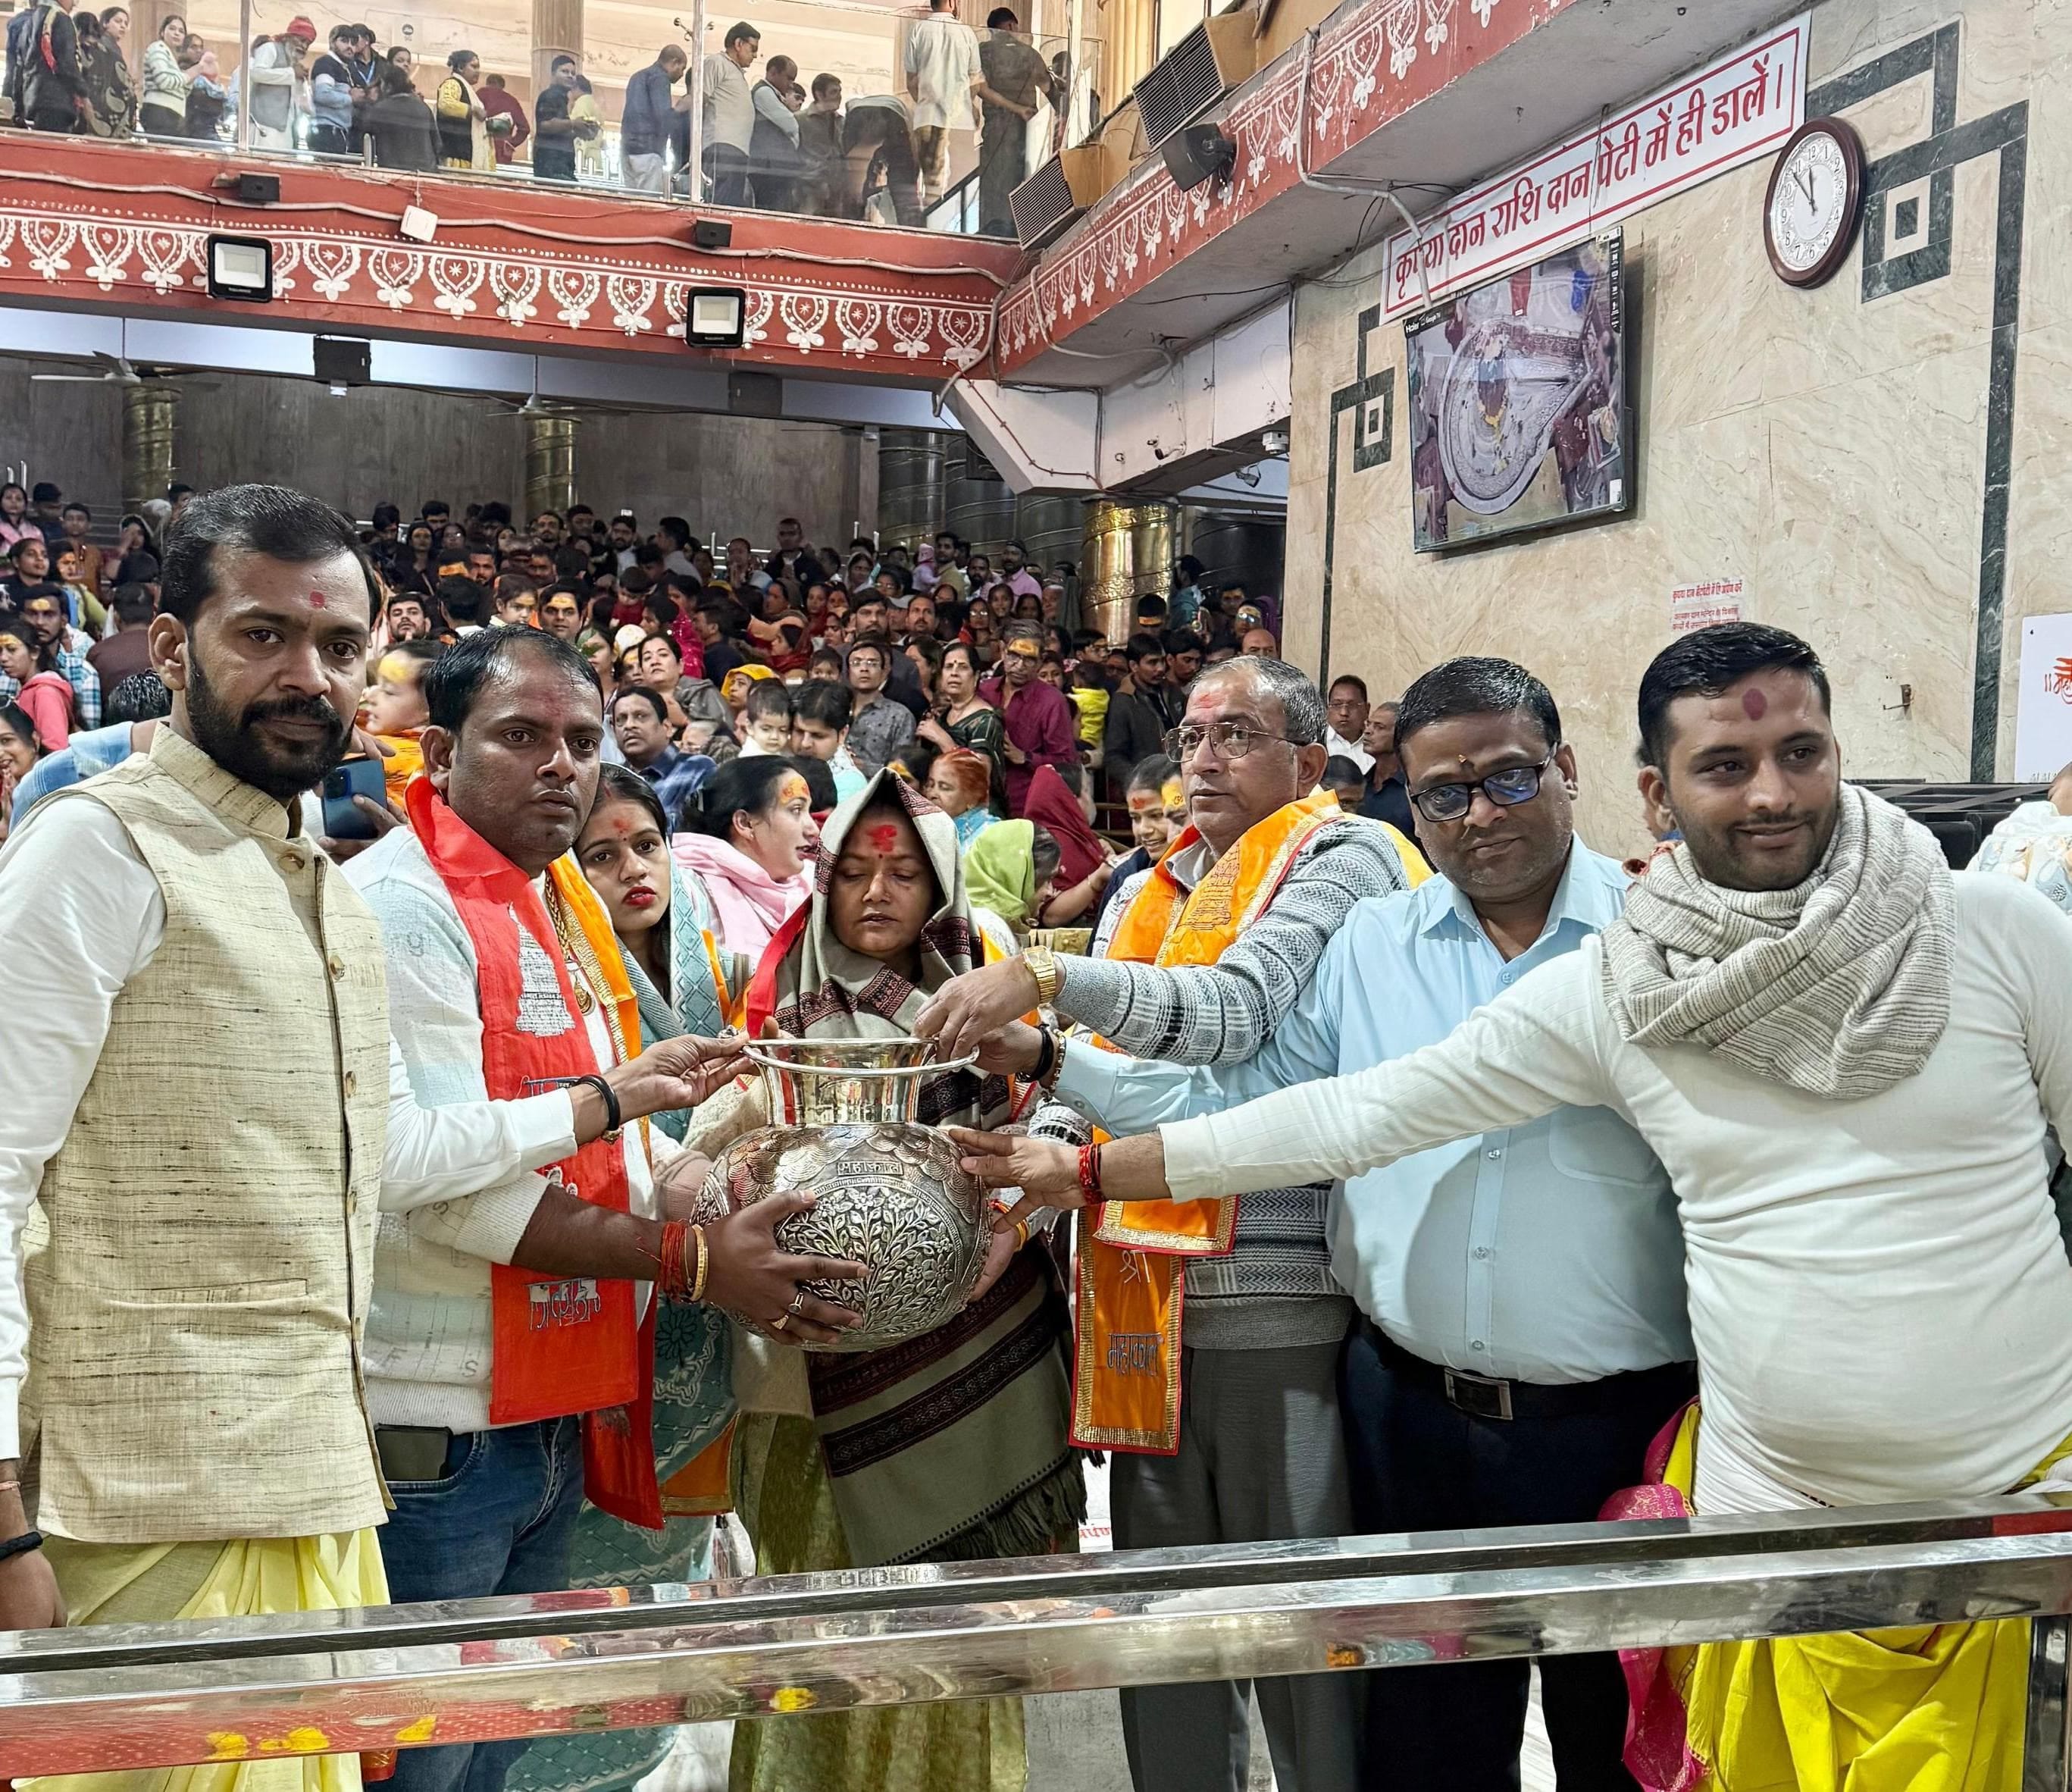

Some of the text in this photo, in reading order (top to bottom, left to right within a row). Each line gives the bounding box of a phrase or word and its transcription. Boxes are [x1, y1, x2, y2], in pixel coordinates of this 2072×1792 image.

[1808, 146, 1817, 161] 12
[1824, 145, 1828, 160] 1
[1834, 156, 1841, 174] 2
[1448, 211, 1486, 261] दान
[1490, 176, 1545, 239] राशि
[1547, 160, 1592, 215] दान
[1596, 121, 1642, 187] पेटी
[1645, 102, 1673, 168] में
[1676, 88, 1707, 156] ही
[1839, 180, 1845, 196] 3
[1781, 208, 1787, 224] 9
[1833, 207, 1840, 221] 4
[1785, 230, 1792, 247] 8
[1823, 230, 1830, 247] 5
[1795, 244, 1801, 260] 7
[1809, 244, 1816, 259] 6
[1107, 1333, 1165, 1377] महाकाल
